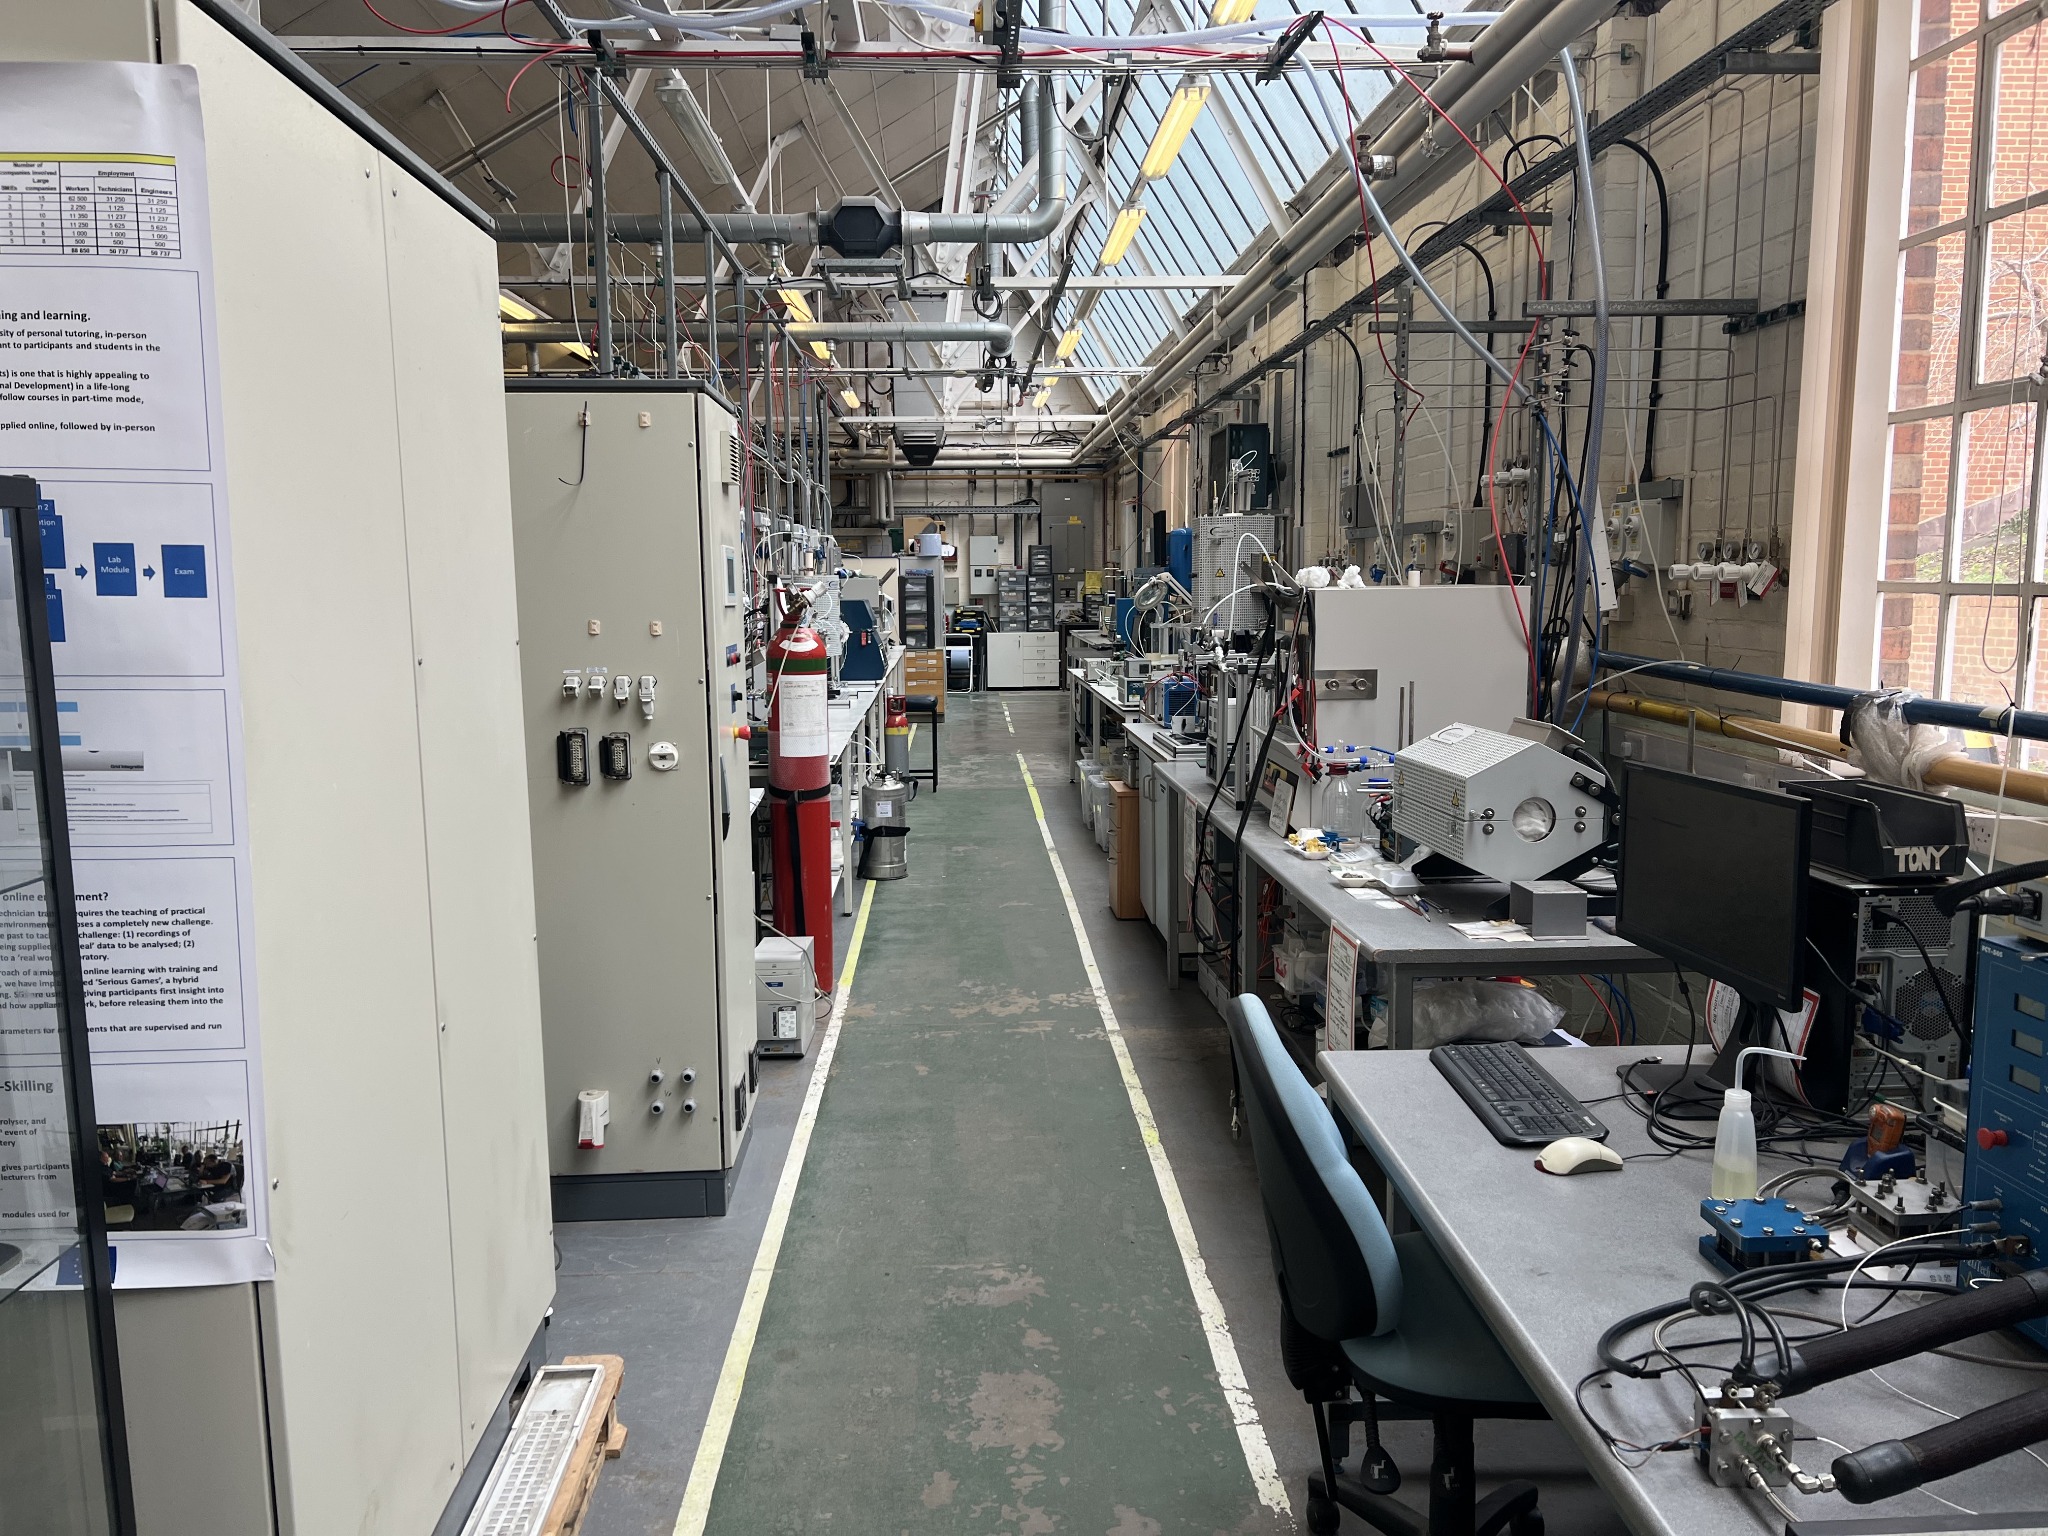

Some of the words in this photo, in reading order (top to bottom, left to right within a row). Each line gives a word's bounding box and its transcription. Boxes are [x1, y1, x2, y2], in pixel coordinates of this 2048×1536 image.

[97, 185, 133, 193] Technicians
[140, 187, 173, 195] Engineers
[0, 310, 18, 322] ing
[20, 310, 40, 320] and
[43, 310, 91, 322] learning.
[16, 329, 25, 337] of
[27, 329, 63, 339] personal
[65, 330, 103, 339] tutoring,
[105, 331, 147, 339] in-person
[24, 341, 73, 351] participants
[76, 342, 92, 350] and
[95, 342, 133, 351] students
[134, 343, 143, 351] in
[146, 344, 161, 352] the
[11, 370, 18, 378] is
[20, 370, 36, 378] one
[38, 370, 55, 378] that
[57, 370, 64, 378] is
[66, 370, 92, 380] highly
[95, 371, 137, 381] appealing
[140, 372, 150, 380] to
[14, 382, 74, 391] Development)
[76, 382, 84, 390] in
[94, 383, 130, 393] life-long
[28, 394, 60, 402] courses
[62, 394, 70, 402] in
[72, 394, 113, 403] part-time
[116, 395, 144, 404] mode,
[28, 422, 58, 431] online,
[60, 422, 99, 431] followed
[101, 423, 111, 432] by
[114, 423, 156, 432] in-person
[108, 556, 122, 564] Lab
[101, 566, 130, 574] Module
[1894, 845, 1949, 872] TONY
[3, 892, 35, 901] online
[121, 908, 158, 917] teaching
[171, 907, 206, 916] practical
[103, 919, 149, 928] completely
[171, 918, 213, 927] challenge.
[78, 931, 121, 940] challenge:
[123, 930, 134, 939] (1)
[136, 930, 180, 938] recordings
[182, 929, 191, 937] of
[97, 942, 116, 950] data
[129, 941, 140, 949] be
[141, 940, 181, 949] analysed;
[184, 940, 195, 949] (2)
[111, 967, 146, 975] learning
[147, 966, 167, 974] with
[169, 966, 201, 974] training
[172, 976, 199, 985] hybrid
[109, 989, 158, 997] participants
[178, 987, 206, 995] insight
[128, 999, 166, 1007] releasing
[144, 1023, 189, 1032] supervised
[1, 1164, 22, 1172] gives
[23, 1163, 70, 1172] participants
